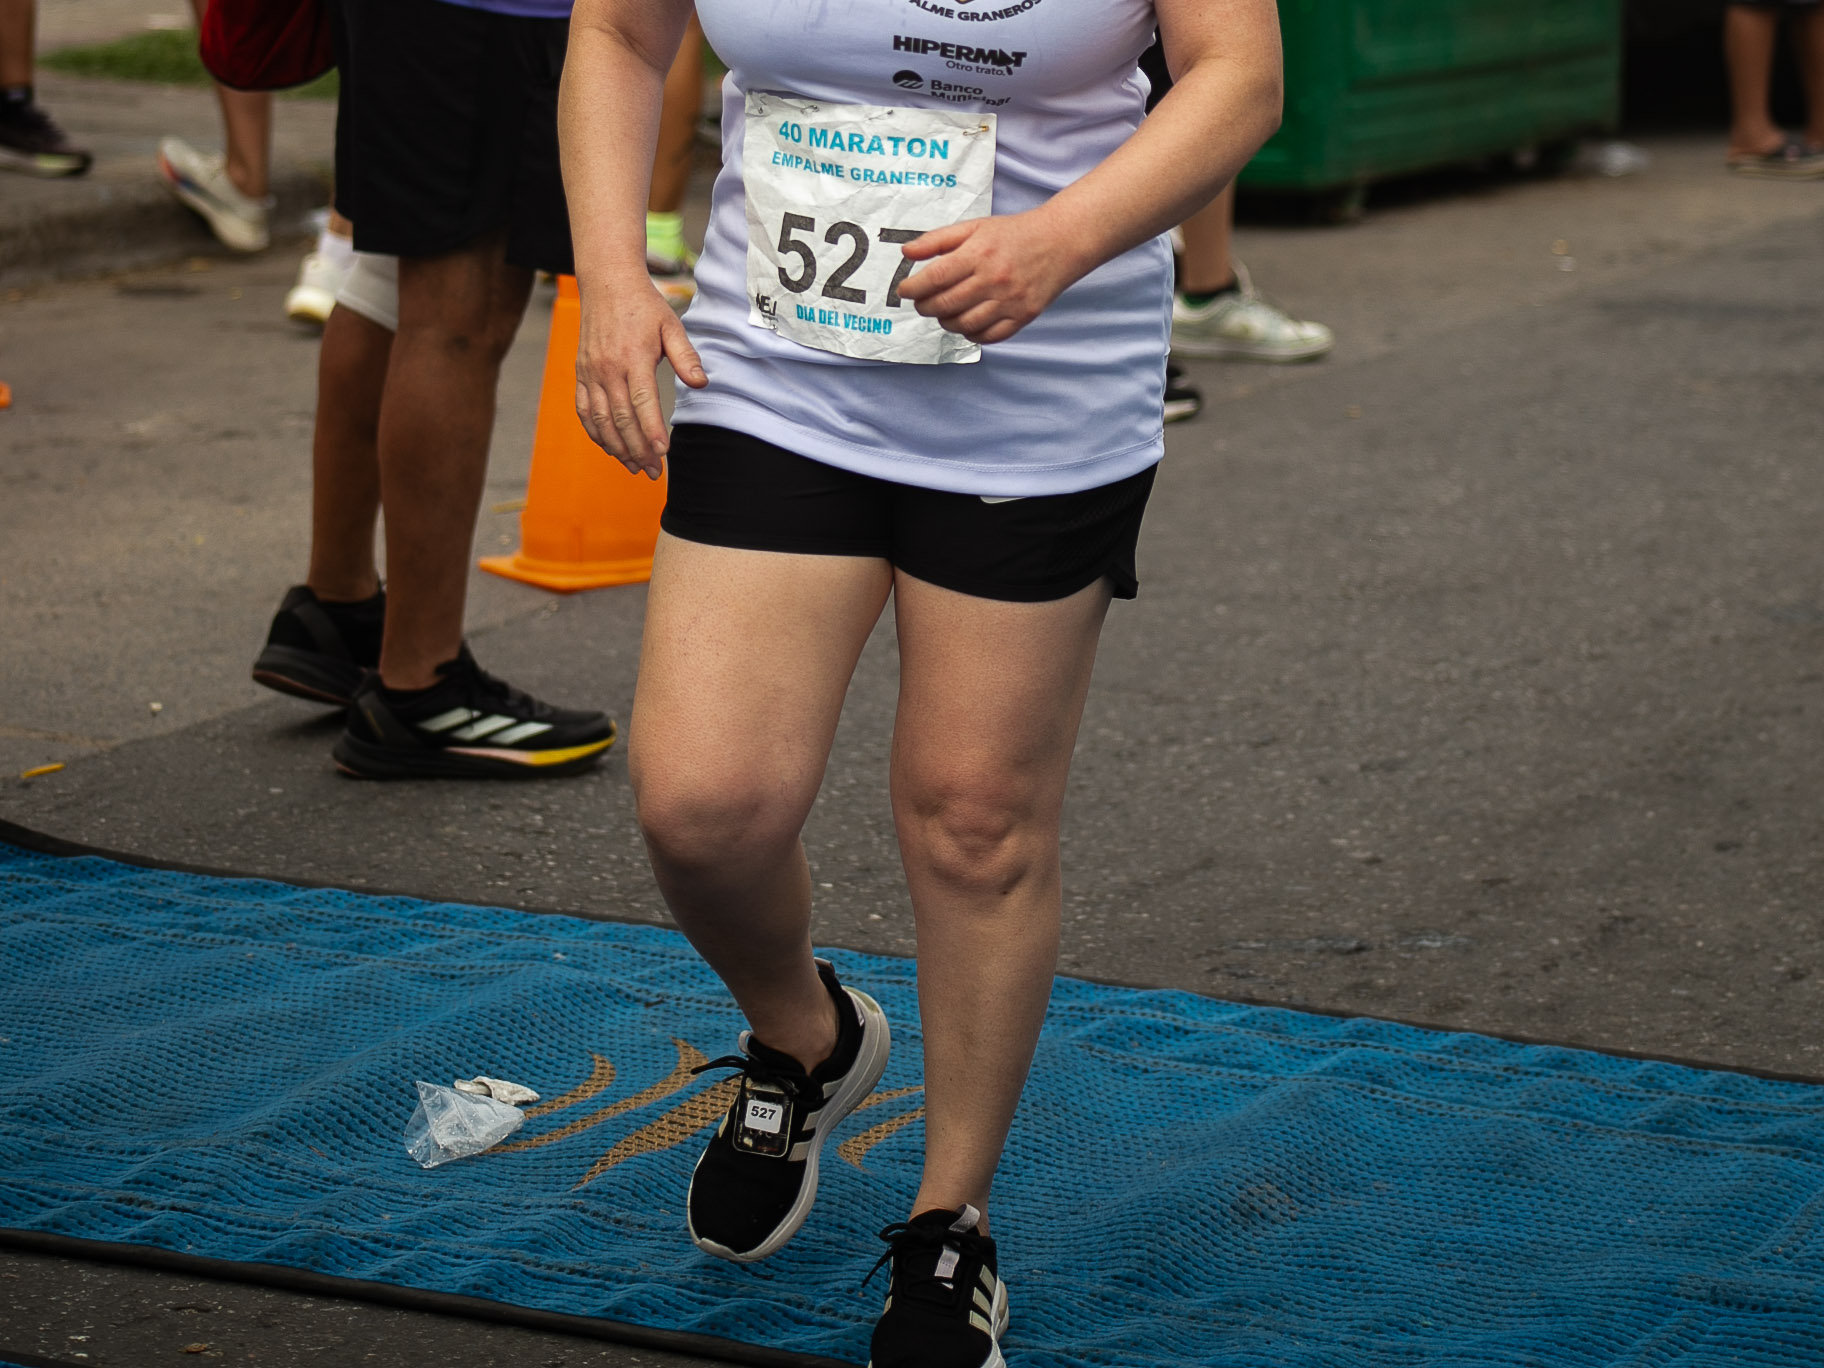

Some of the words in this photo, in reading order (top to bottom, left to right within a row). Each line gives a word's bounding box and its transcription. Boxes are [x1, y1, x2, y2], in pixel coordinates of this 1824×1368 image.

[946, 60, 973, 72] Otro
[931, 80, 984, 95] Banco
[778, 121, 801, 143] 40
[808, 127, 949, 160] MARATON
[772, 151, 845, 178] EMPALME
[850, 167, 958, 188] GRANEROS
[777, 211, 932, 308] 527
[796, 304, 816, 323] DIA
[818, 309, 840, 327] DEL
[844, 313, 893, 335] VECINO
[751, 1106, 777, 1121] 527
